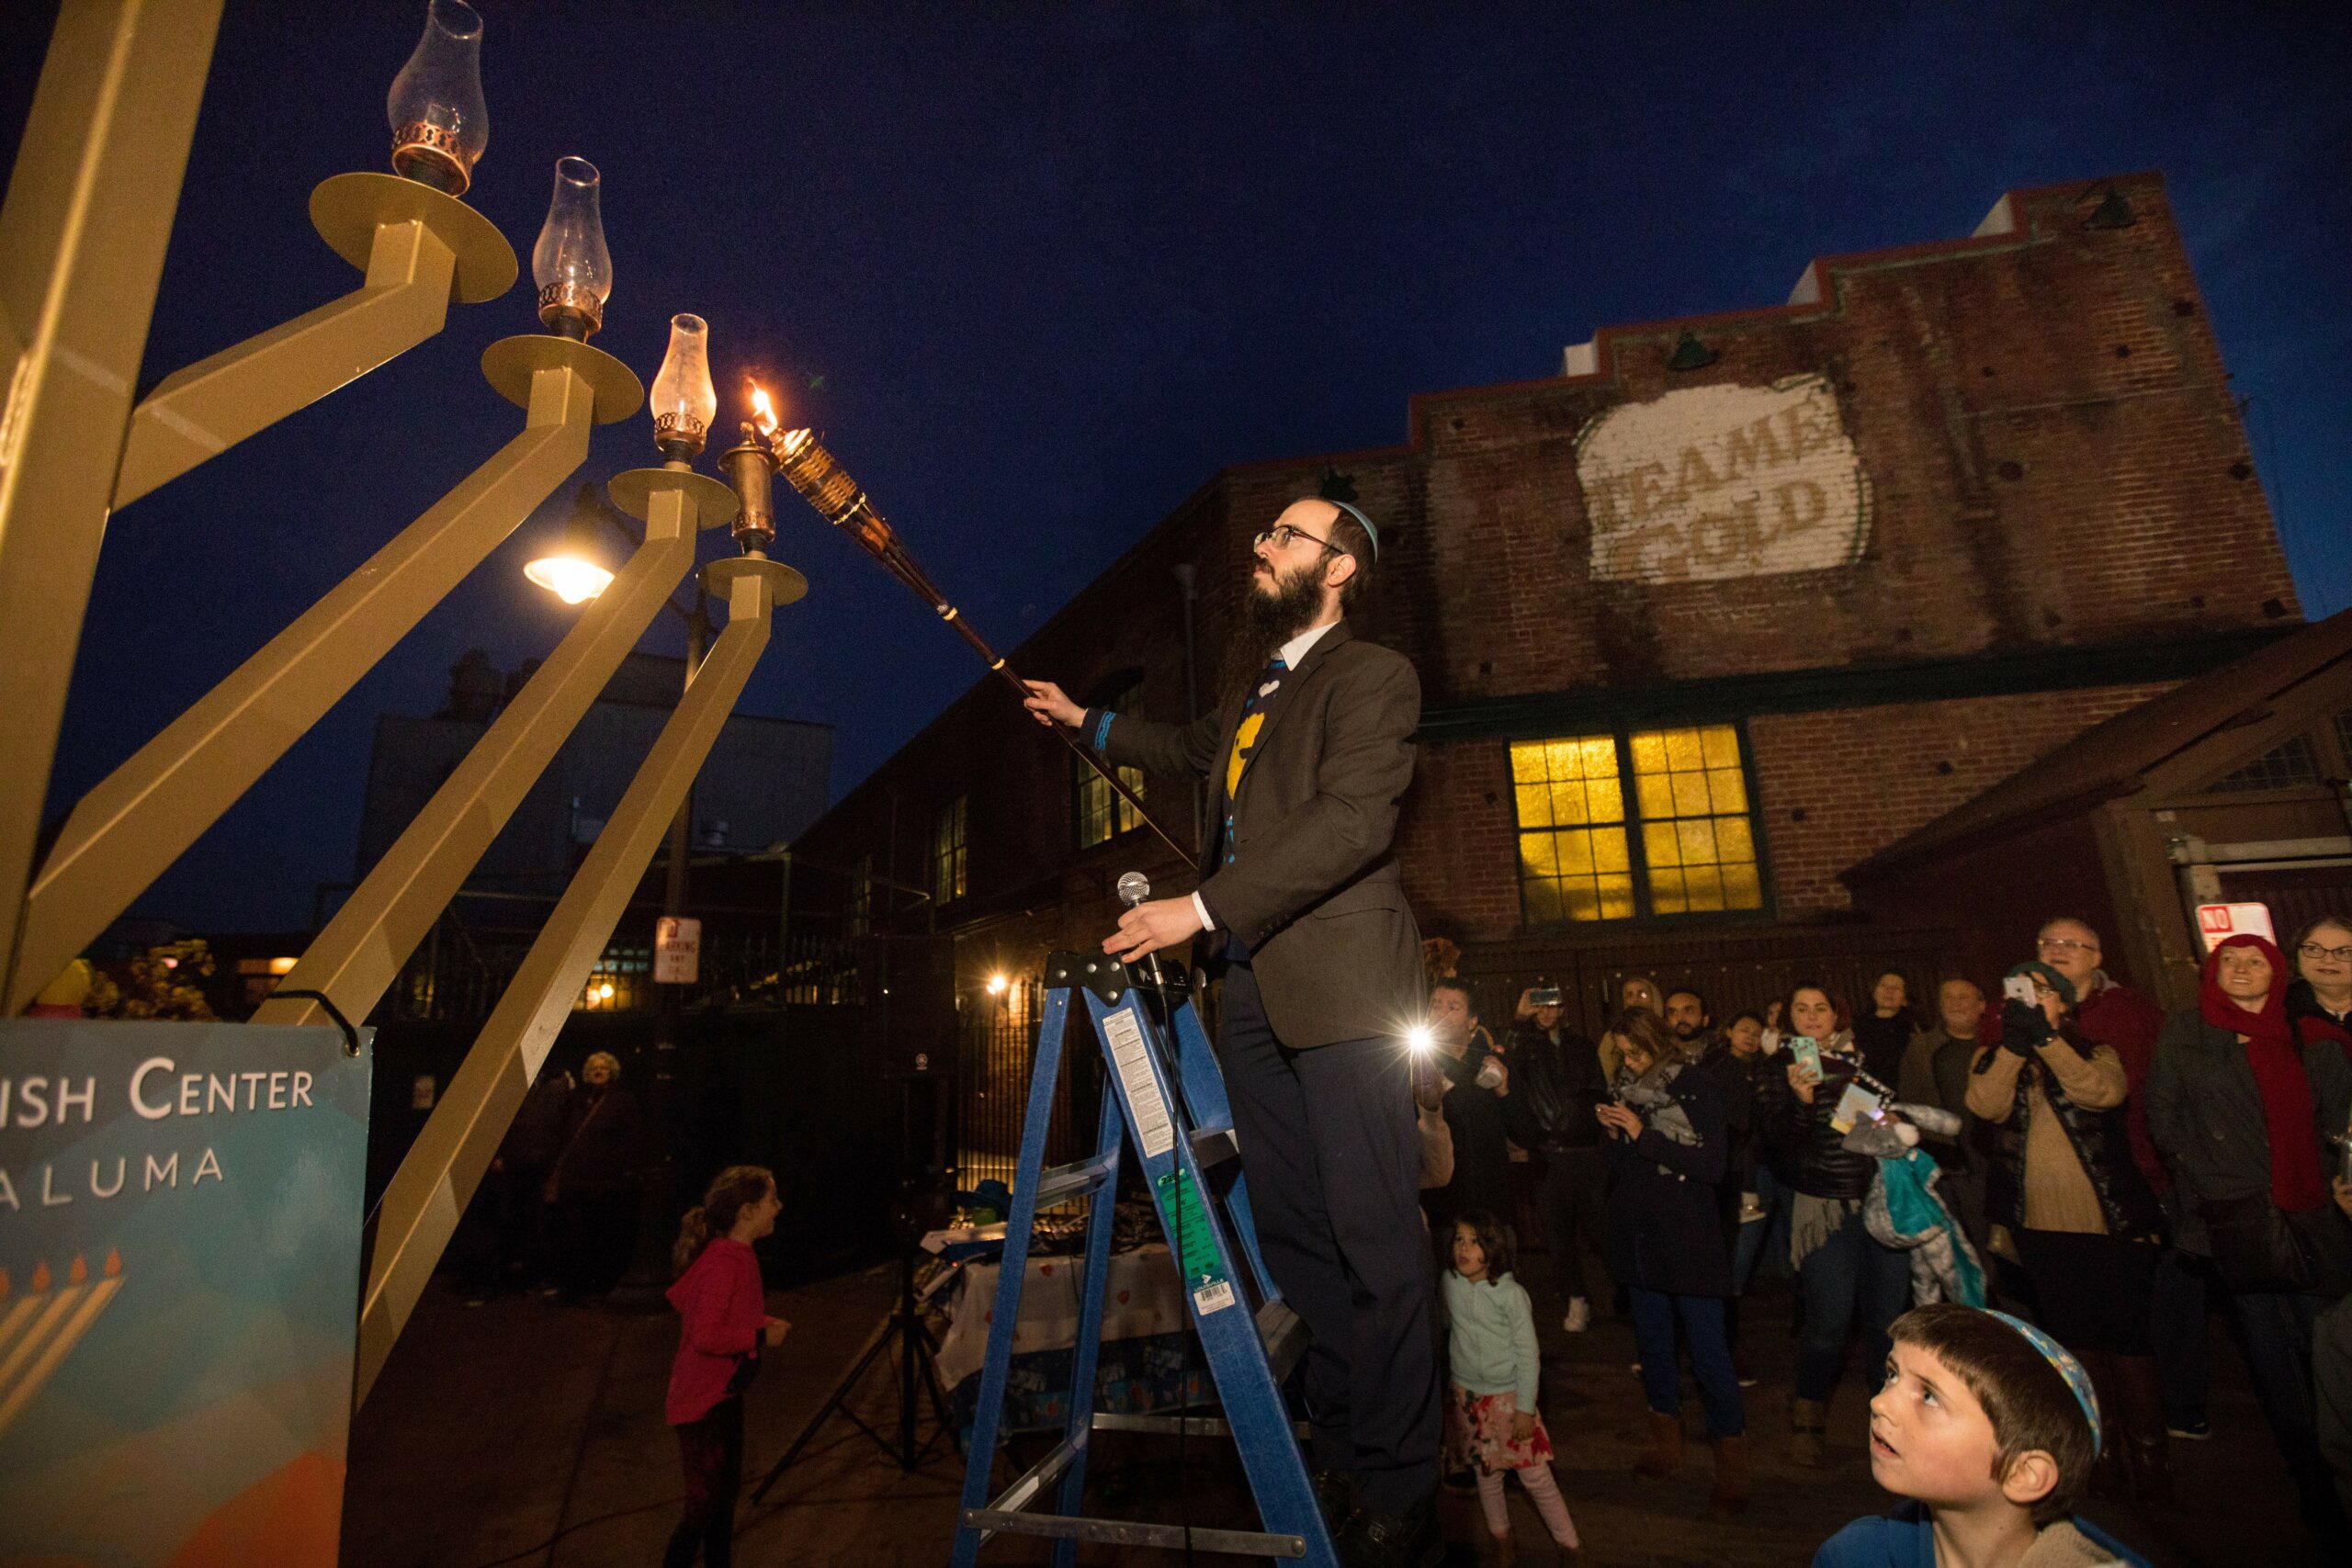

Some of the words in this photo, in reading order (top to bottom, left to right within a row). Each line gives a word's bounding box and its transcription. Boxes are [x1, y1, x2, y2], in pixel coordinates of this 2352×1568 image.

[2201, 908, 2229, 930] NO
[659, 941, 696, 953] ARKING
[129, 1056, 314, 1120] CENTER
